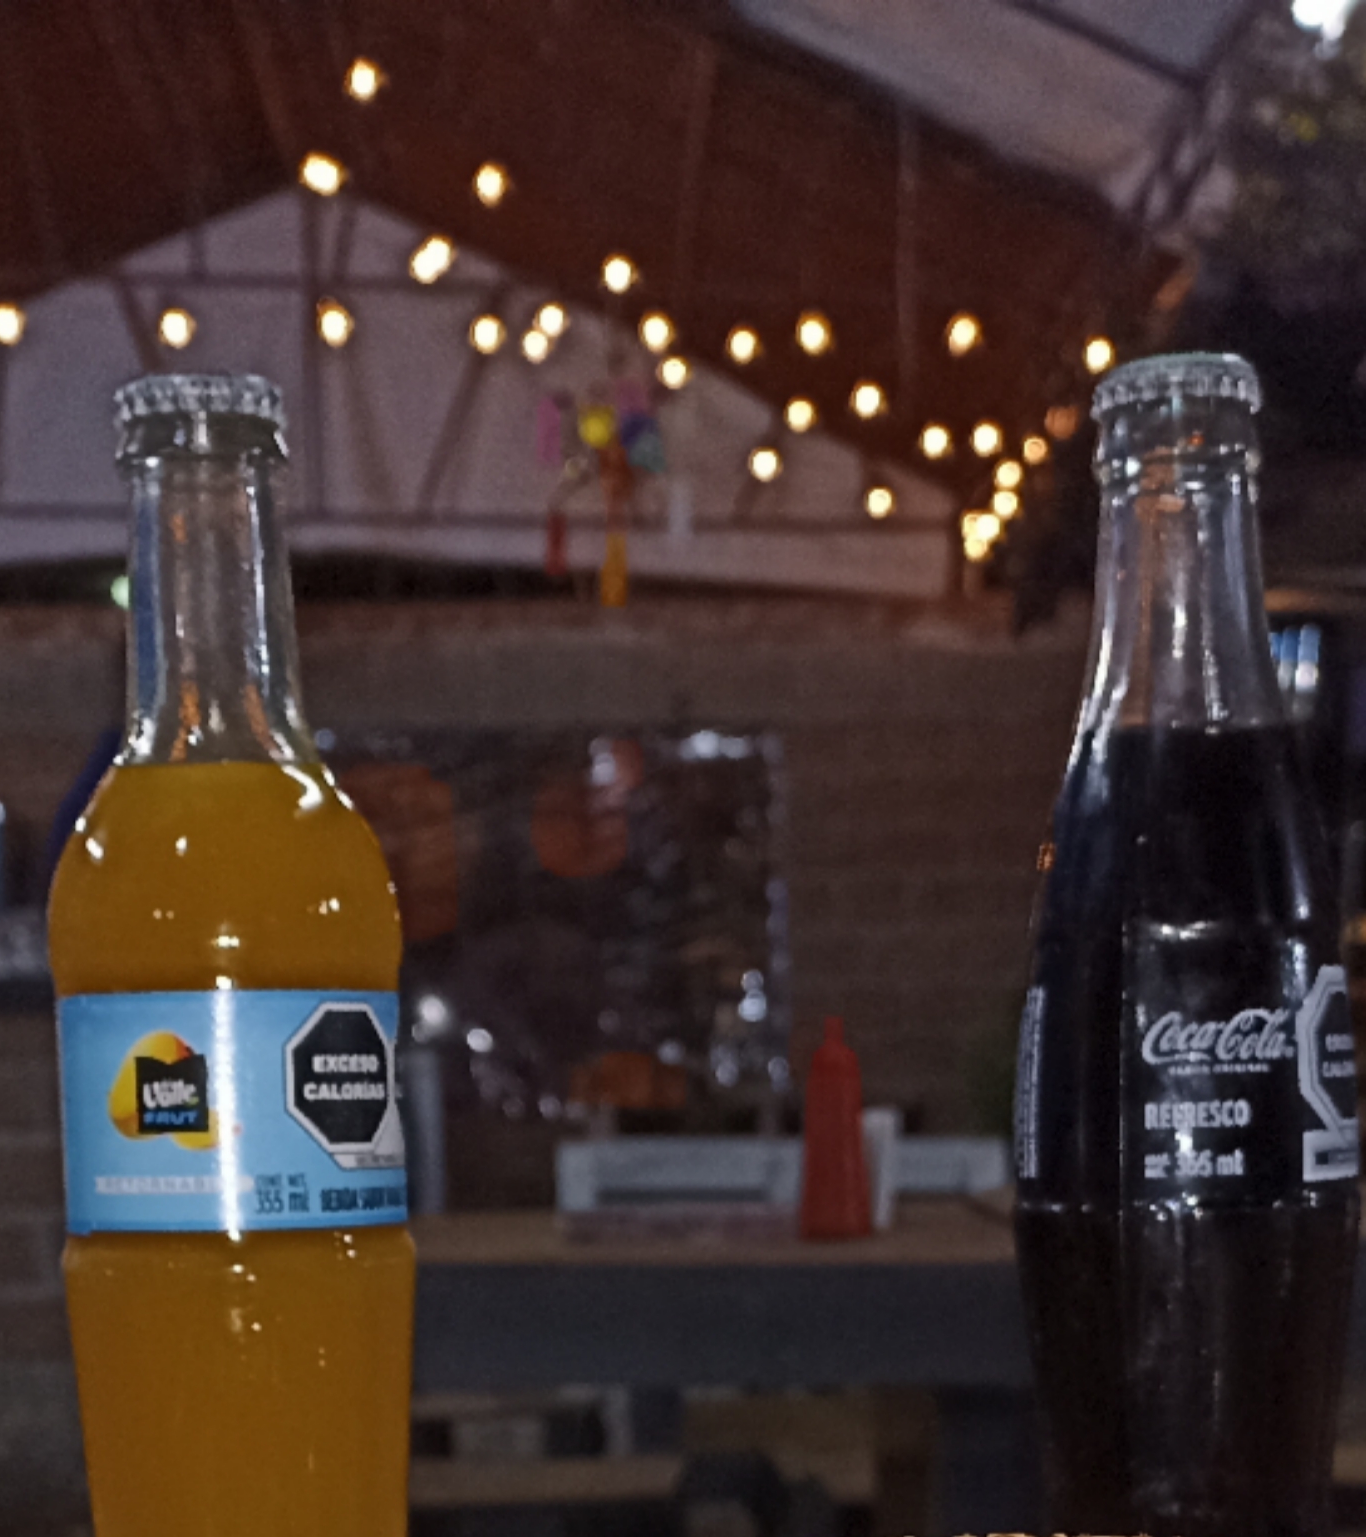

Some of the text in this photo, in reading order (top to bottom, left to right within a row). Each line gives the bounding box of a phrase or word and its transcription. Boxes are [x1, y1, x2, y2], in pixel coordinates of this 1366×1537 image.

[1142, 1008, 1288, 1065] Coca-Cola
[312, 1053, 379, 1074] EXCESO
[1144, 1099, 1251, 1130] REFRESCO
